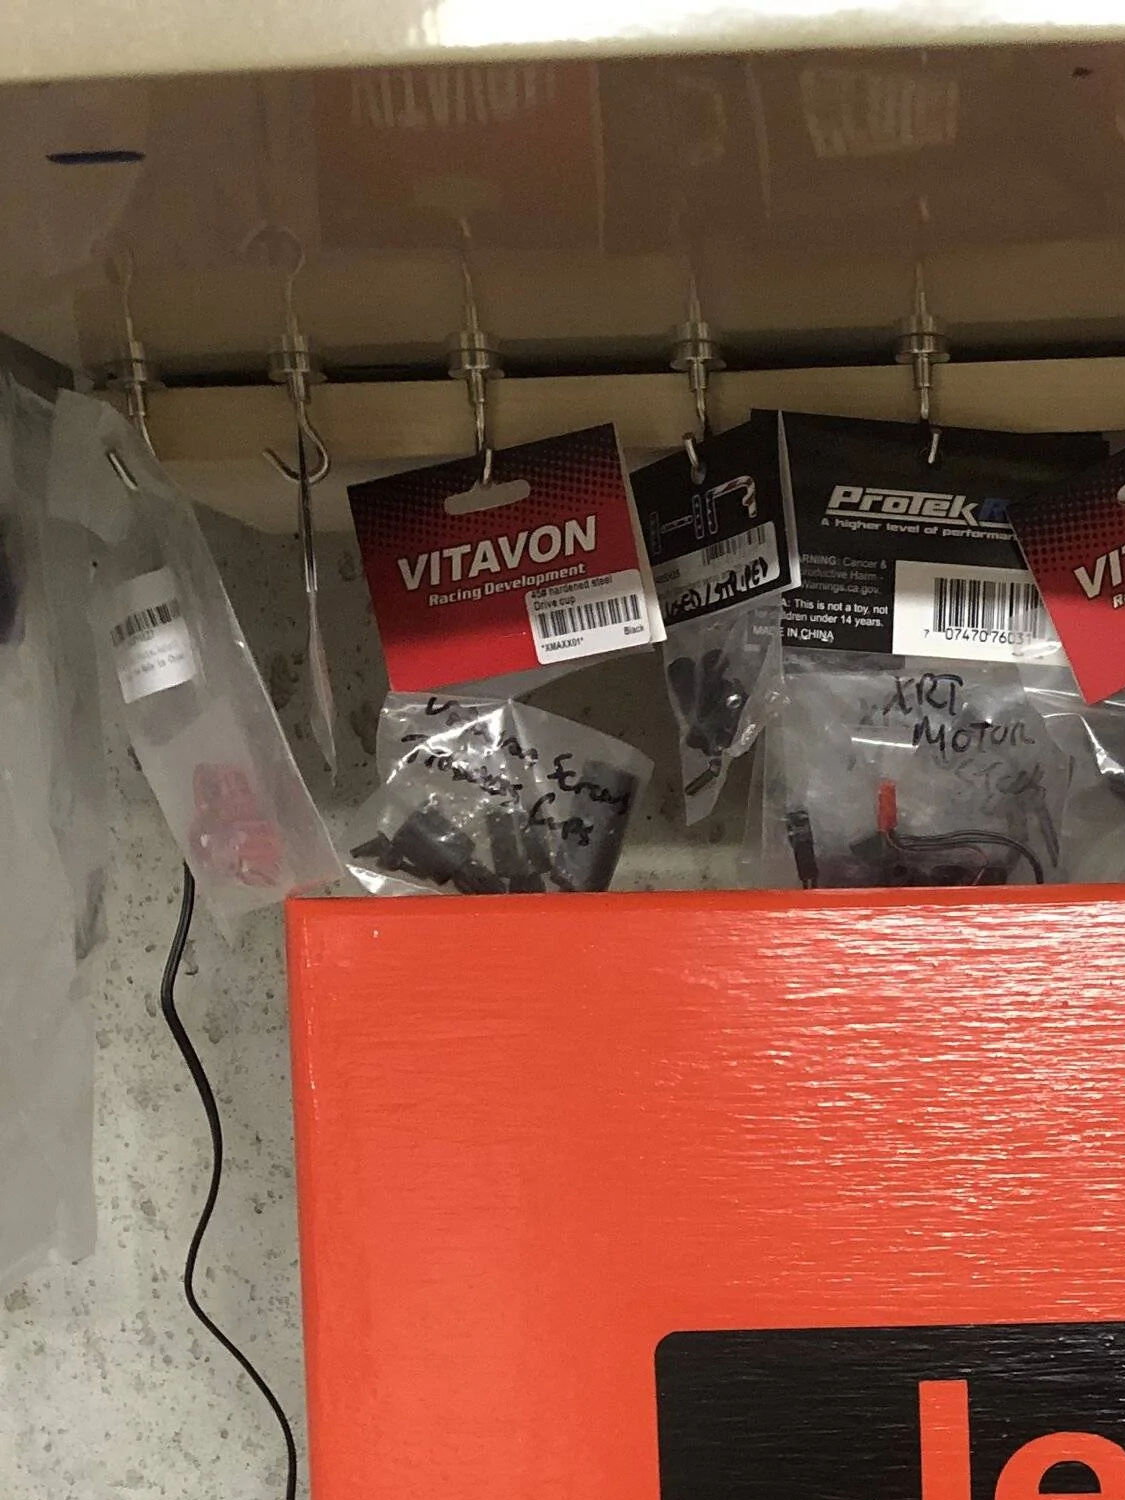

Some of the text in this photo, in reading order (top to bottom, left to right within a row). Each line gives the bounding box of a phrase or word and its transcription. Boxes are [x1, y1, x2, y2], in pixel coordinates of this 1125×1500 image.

[834, 518, 881, 532] higher
[886, 522, 920, 534] level
[923, 526, 939, 535] of
[397, 515, 597, 591] VITAVON
[429, 563, 587, 607] Racing Development
[533, 599, 558, 612] Drive
[794, 598, 814, 609] This
[816, 600, 825, 610] is
[827, 601, 843, 612] not
[844, 604, 852, 612] a
[873, 605, 889, 615] not
[809, 613, 838, 624] under
[840, 614, 852, 625] 14
[623, 624, 644, 636] Black
[786, 627, 798, 638] IN
[800, 628, 835, 641] CHINA
